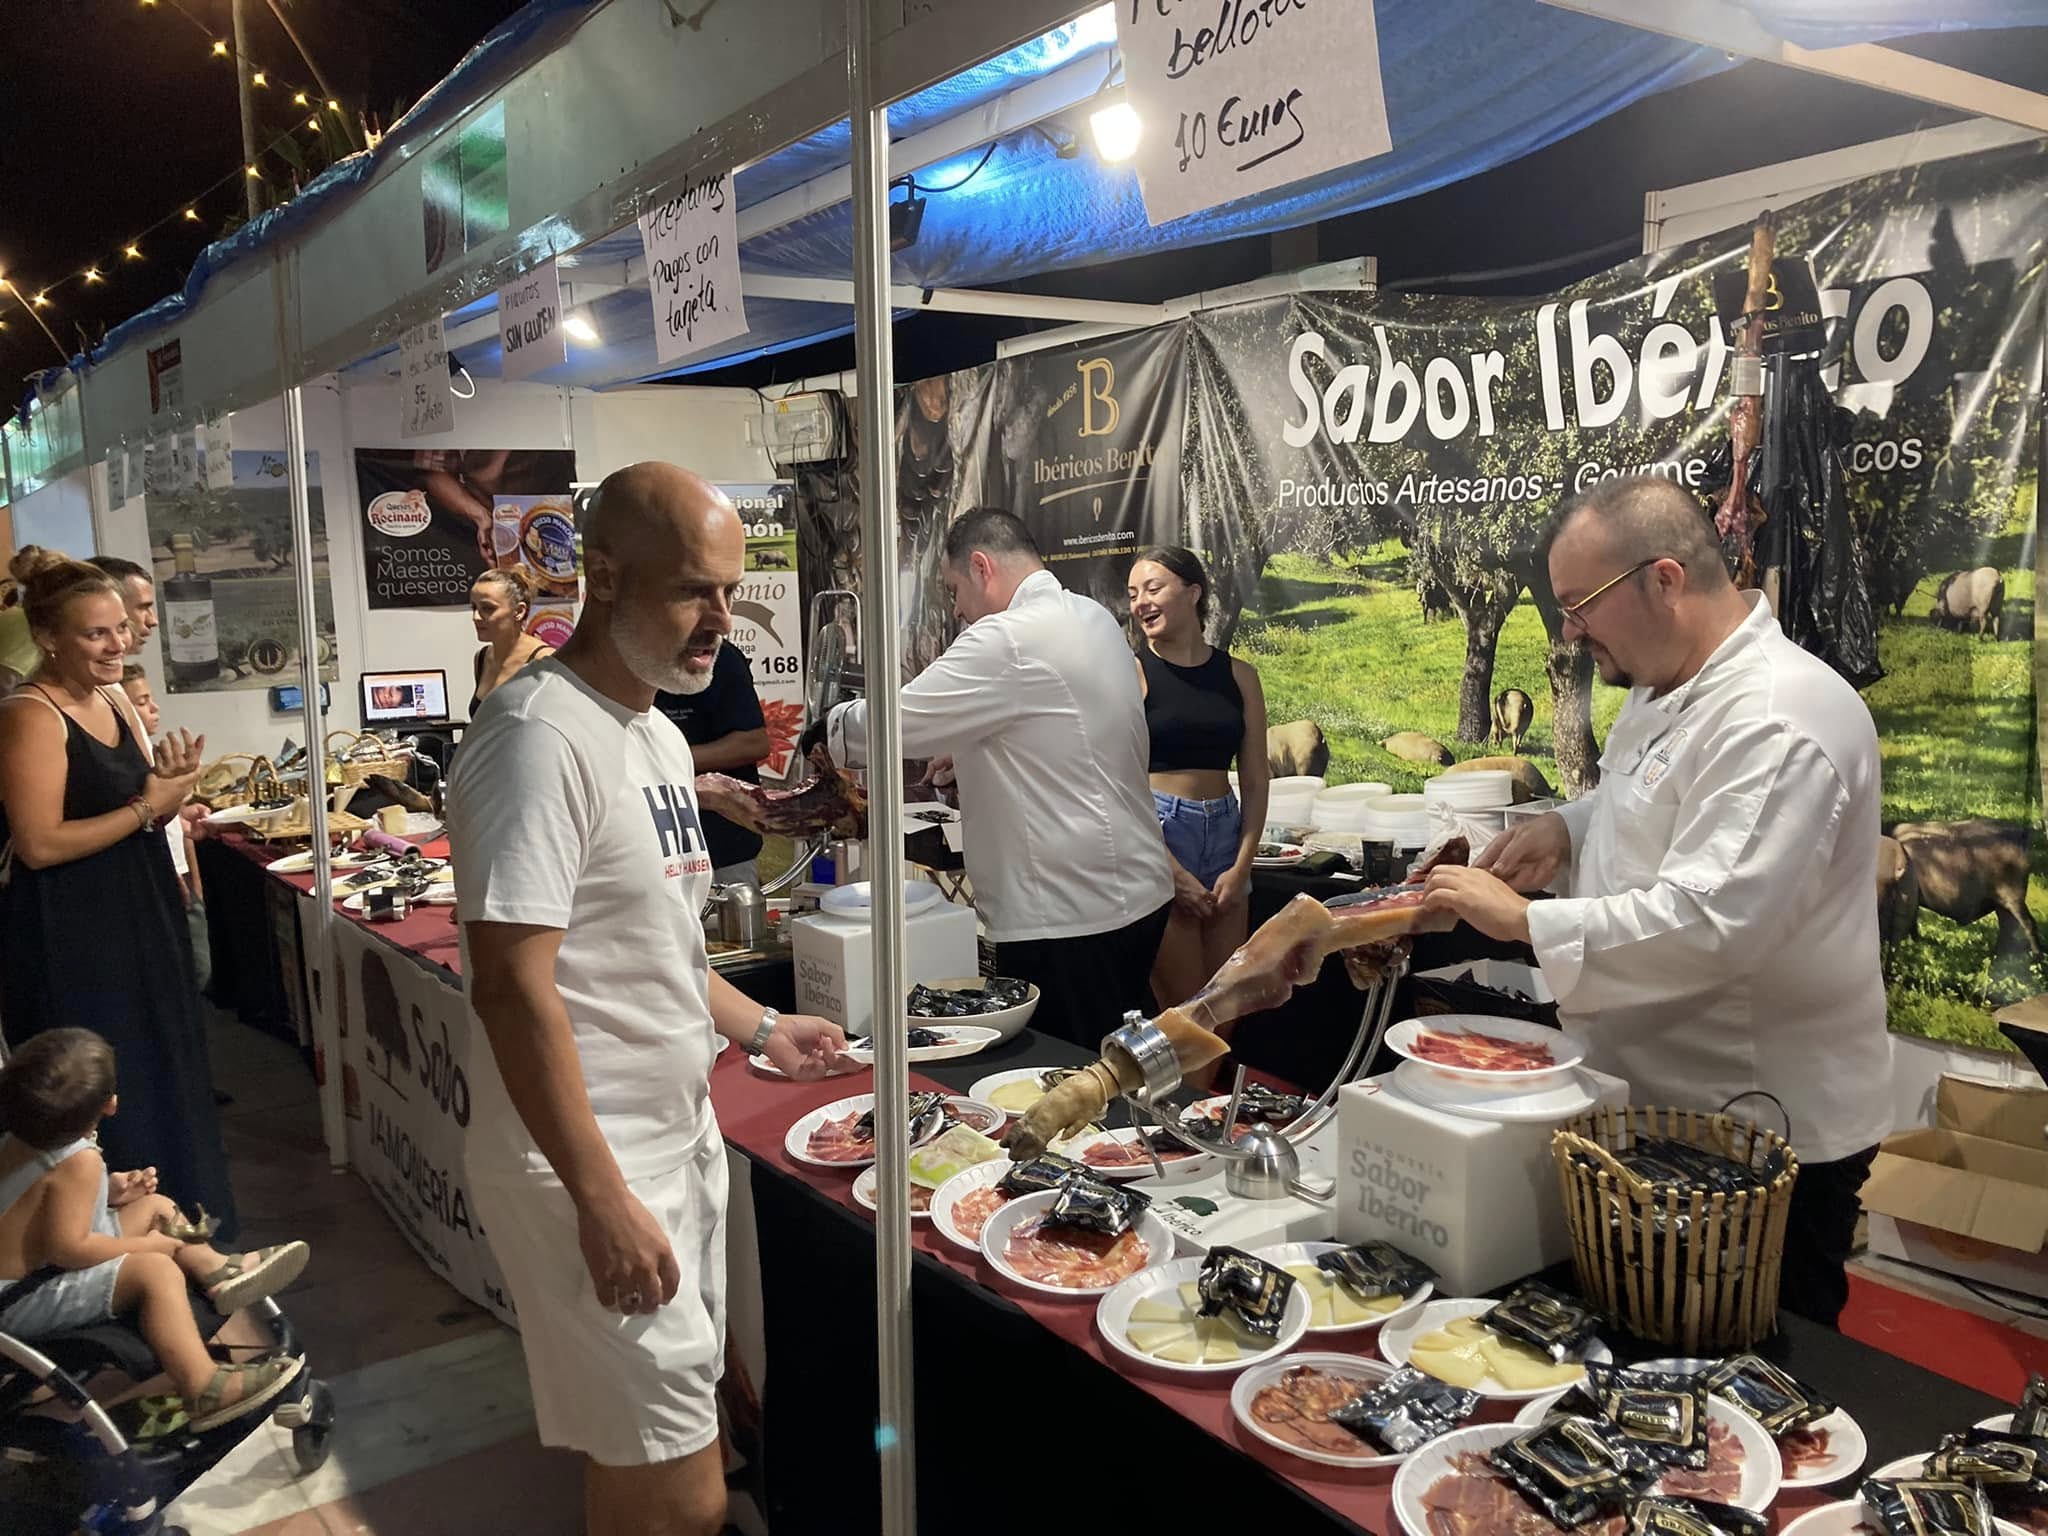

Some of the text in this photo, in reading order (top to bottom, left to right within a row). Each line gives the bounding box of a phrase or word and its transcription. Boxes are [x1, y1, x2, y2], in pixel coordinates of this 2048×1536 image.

[1175, 88, 1304, 172] 10 Euros
[648, 173, 725, 249] Aceptamos
[653, 234, 719, 294] Pagos con
[665, 273, 717, 342] tarjeta
[506, 324, 523, 353] SIN
[1077, 358, 1120, 437] B
[1283, 324, 1506, 448] Sabor
[1034, 454, 1103, 484] Ibéricos
[1279, 475, 1388, 508] Productos
[1395, 473, 1543, 505] Artesanos
[371, 512, 428, 525] Rocinante
[376, 562, 466, 580] Maestros
[762, 656, 798, 674] 168
[664, 859, 710, 879] HELLY HANSEN
[800, 960, 832, 986] Sabor
[1351, 1149, 1430, 1204] Sabor
